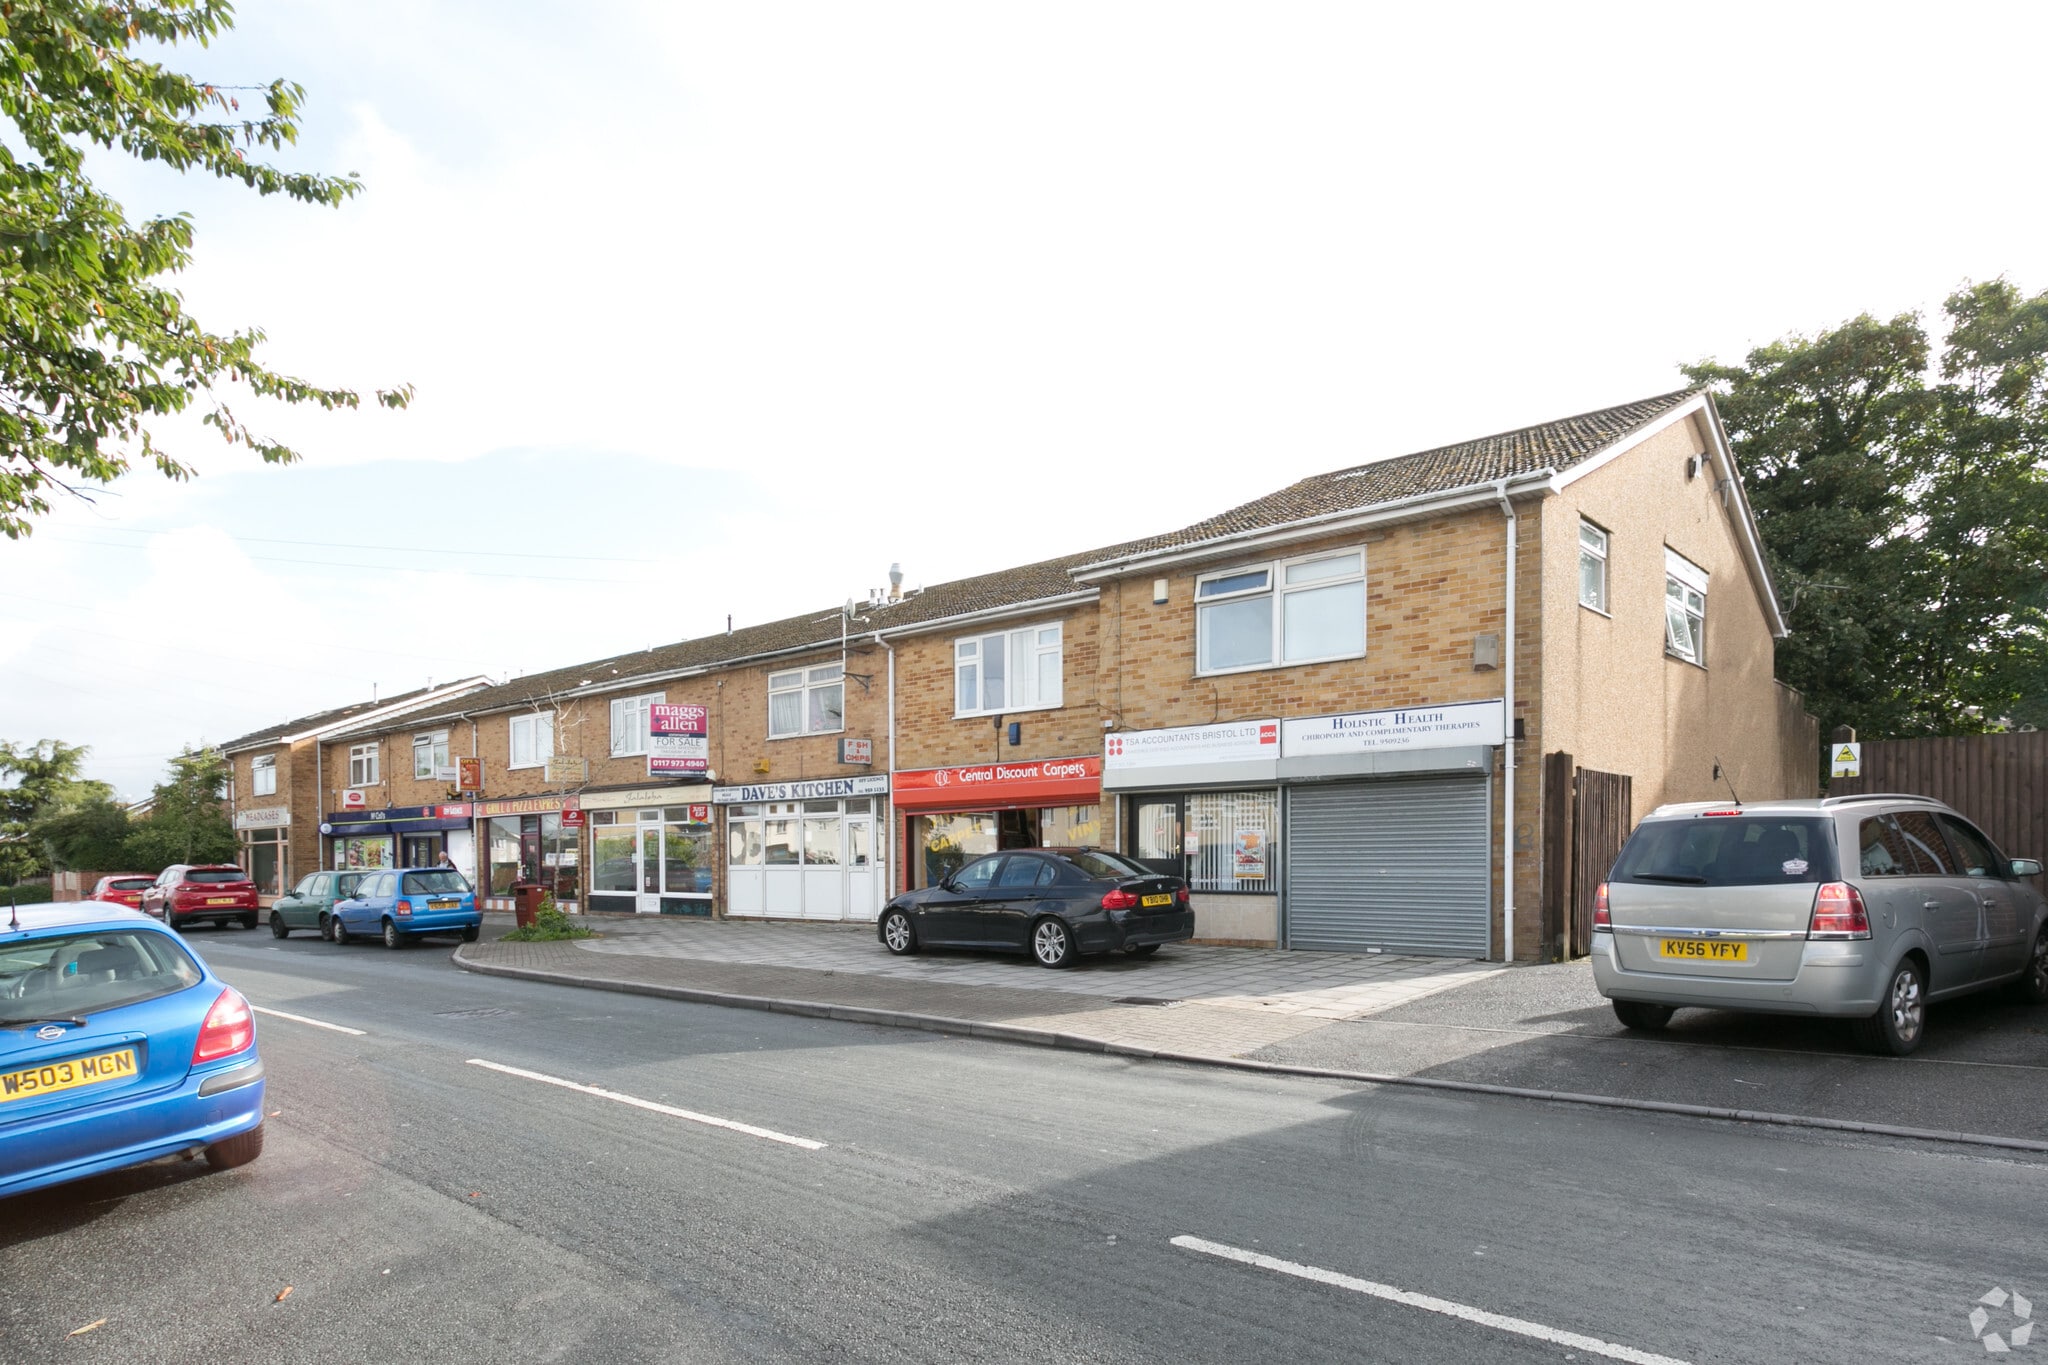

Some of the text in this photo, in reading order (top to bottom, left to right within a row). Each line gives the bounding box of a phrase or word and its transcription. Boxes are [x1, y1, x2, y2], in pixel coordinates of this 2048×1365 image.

[655, 705, 705, 720] maggs
[1394, 713, 1443, 725] HEALTH
[661, 717, 698, 730] allen
[1126, 728, 1256, 746] TSA ACCOUNTANTS BRISTOL LTD
[1302, 722, 1480, 741] CHIROPODY AND COMPLIMENTARY THERAPIES
[656, 738, 701, 746] FOR SALE
[846, 754, 870, 762] CHIPS
[959, 769, 993, 782] Central
[996, 767, 1038, 780] Discount
[1043, 762, 1085, 778] Carpets
[741, 780, 854, 800] DAVE'S KITCHEN
[486, 802, 506, 814] GRILL
[512, 799, 533, 812] PIZZA
[1666, 942, 1740, 958] KV56 YFY
[2, 1064, 74, 1095] W503
